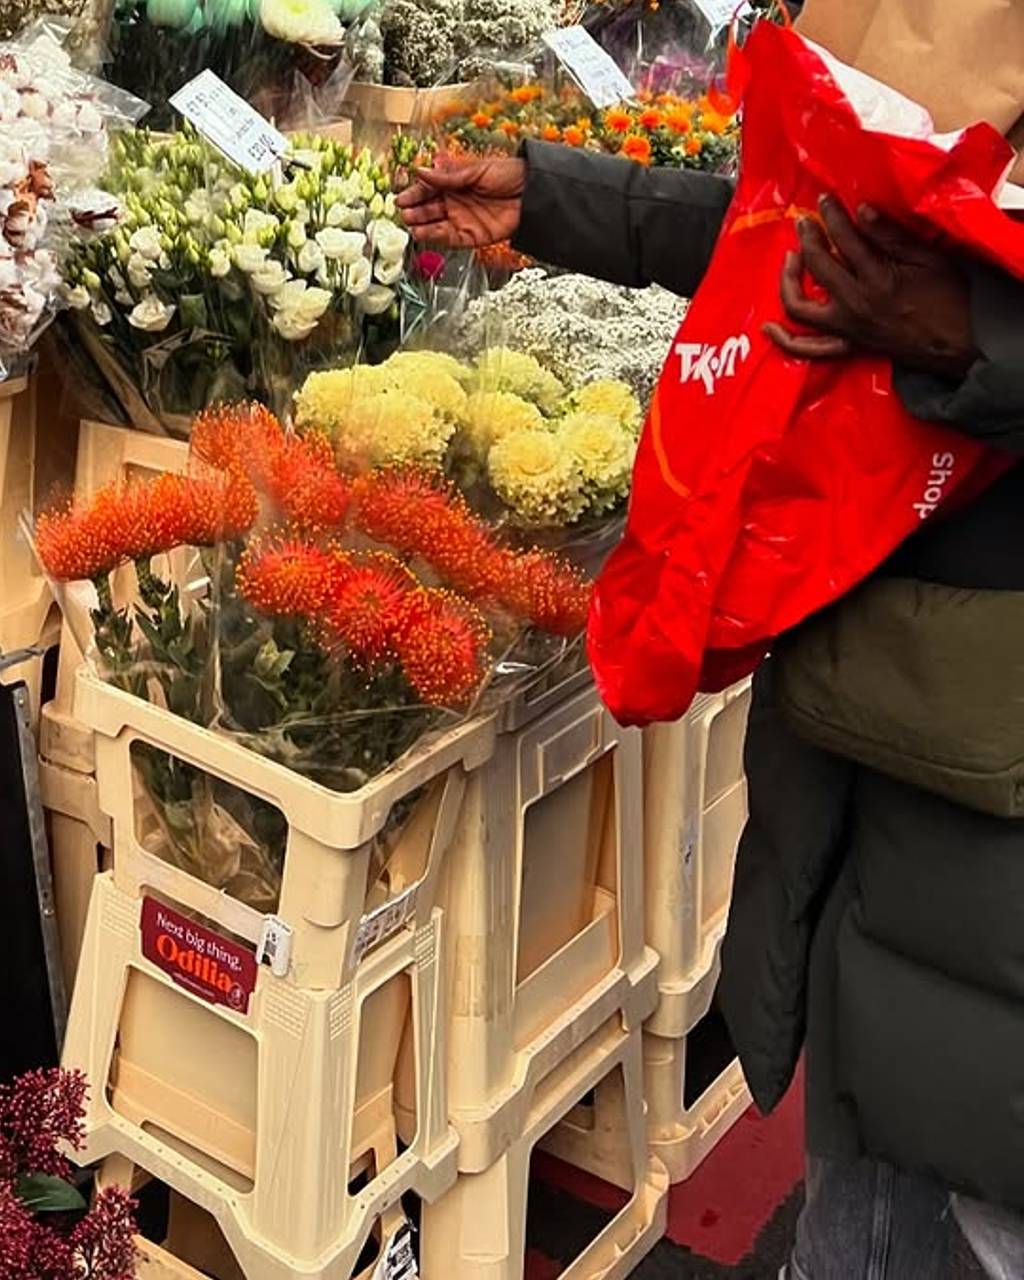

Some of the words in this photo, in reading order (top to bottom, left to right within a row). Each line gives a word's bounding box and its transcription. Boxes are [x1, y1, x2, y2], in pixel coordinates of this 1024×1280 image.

[156, 912, 184, 939] Next
[185, 929, 205, 954] big
[206, 943, 242, 972] thing.
[156, 934, 233, 993] Odilia
